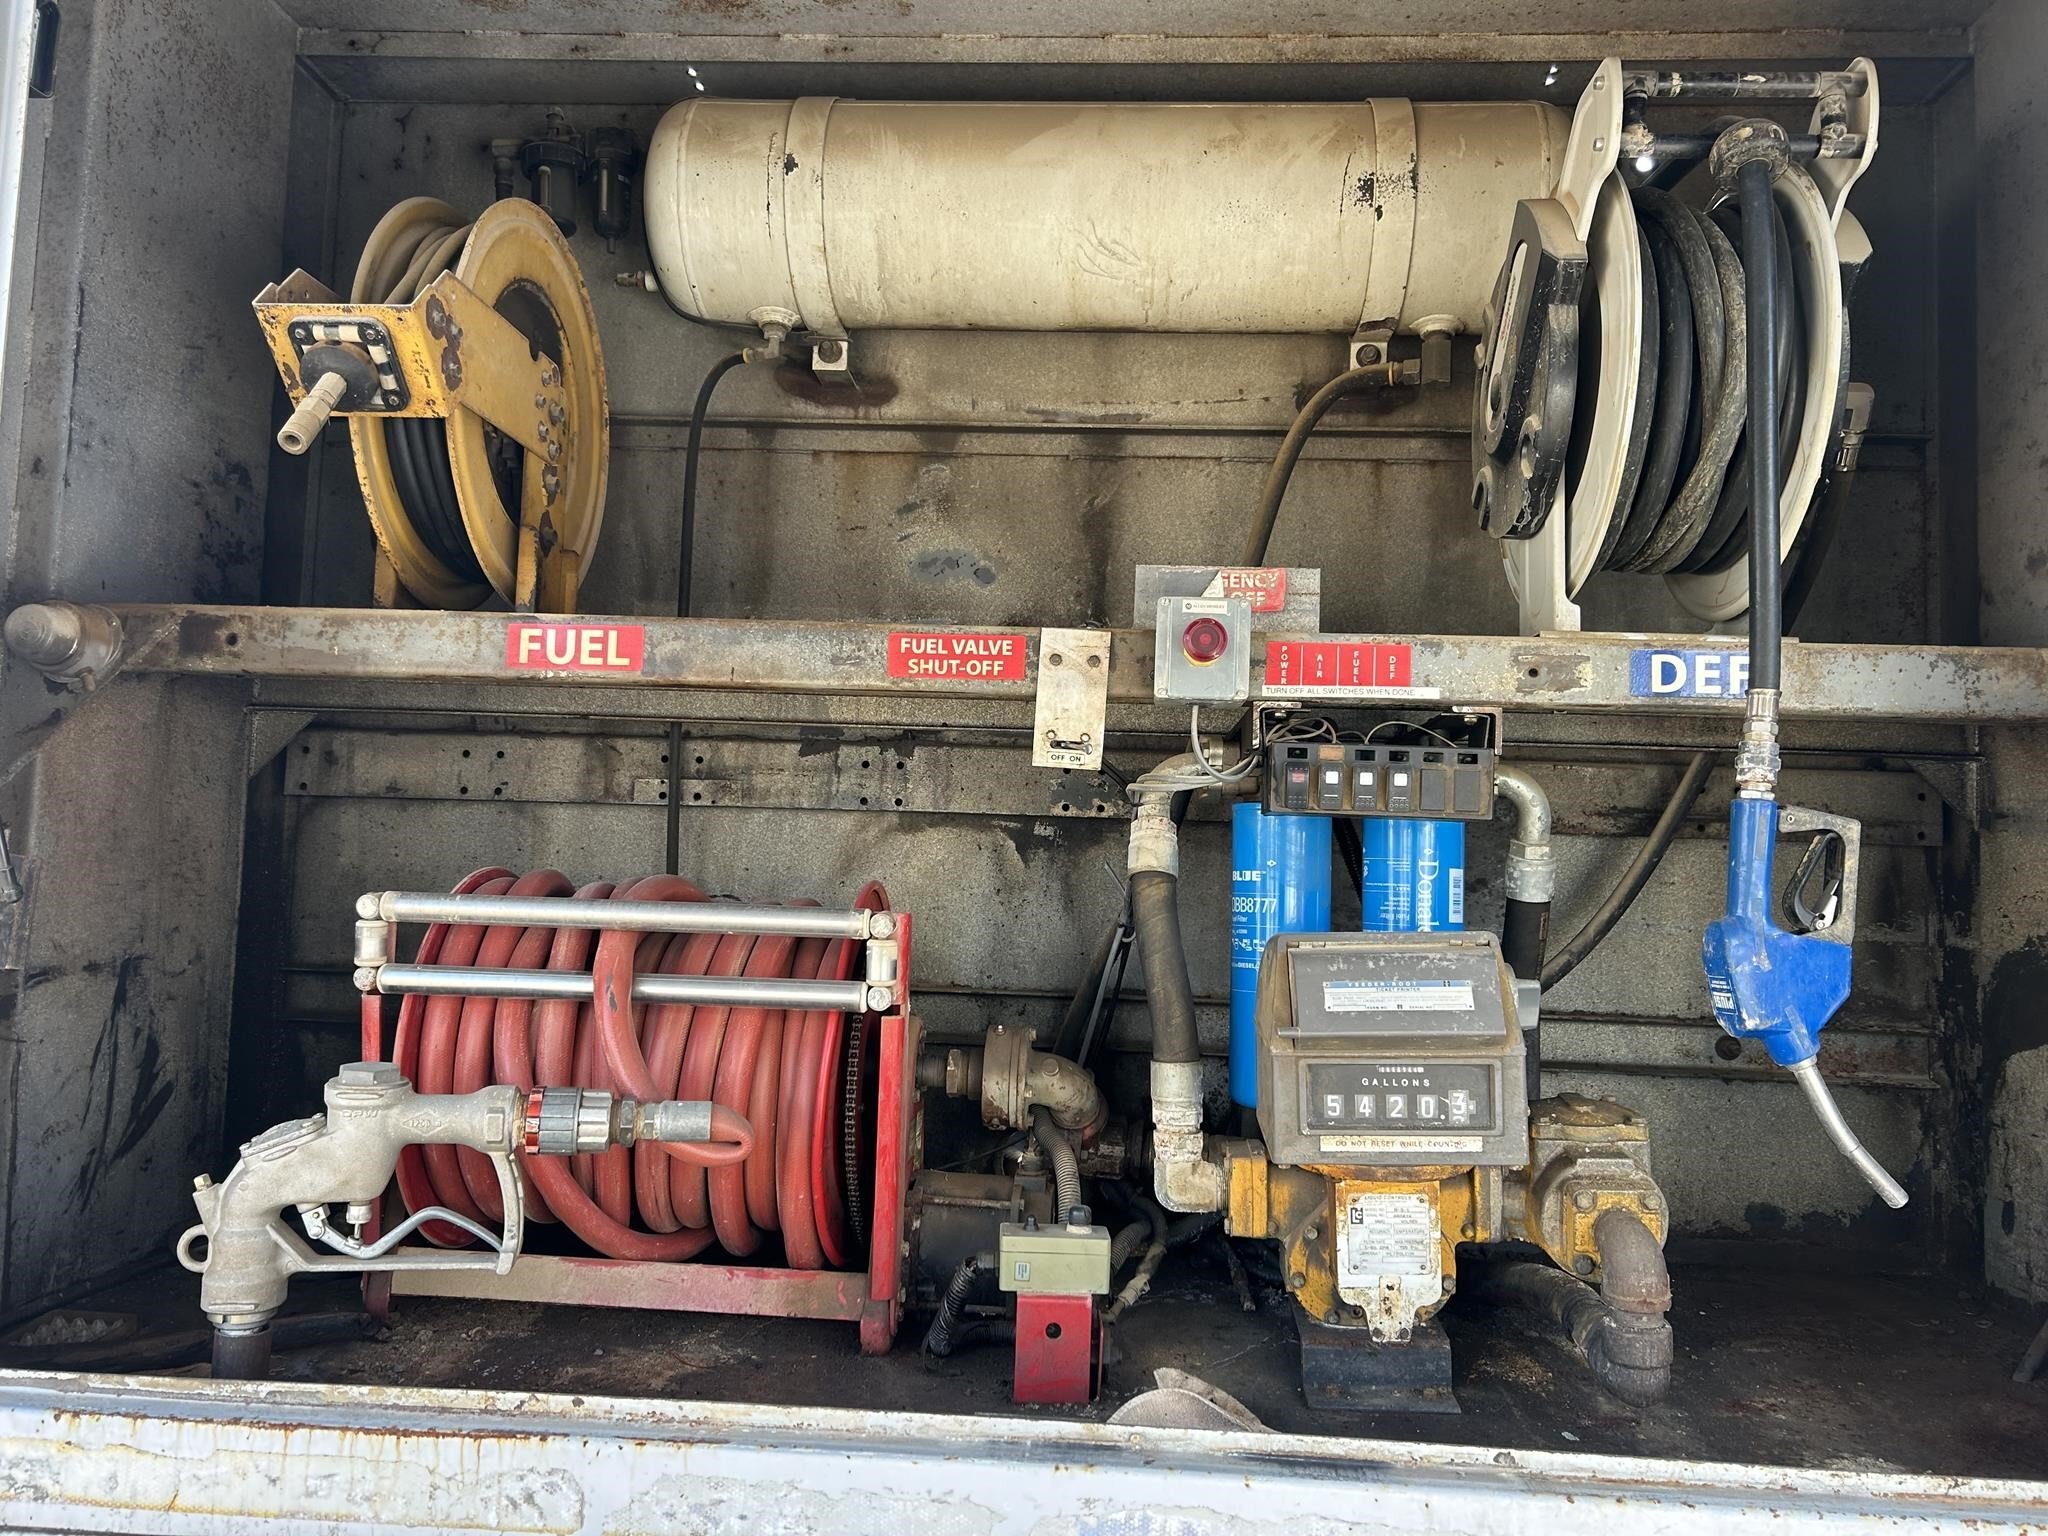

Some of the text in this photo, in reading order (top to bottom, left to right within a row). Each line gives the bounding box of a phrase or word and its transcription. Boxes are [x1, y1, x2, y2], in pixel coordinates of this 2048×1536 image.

[518, 627, 631, 666] FUEL
[900, 637, 1014, 656] FUEL VALVE
[908, 657, 1004, 677] SHUT-OFF
[1280, 645, 1289, 685] POWER
[1651, 654, 1750, 694] DEF
[1266, 687, 1415, 697] TURN OFF ALL SWITCHES WHEN DONE
[1361, 1077, 1431, 1087] GALLONS
